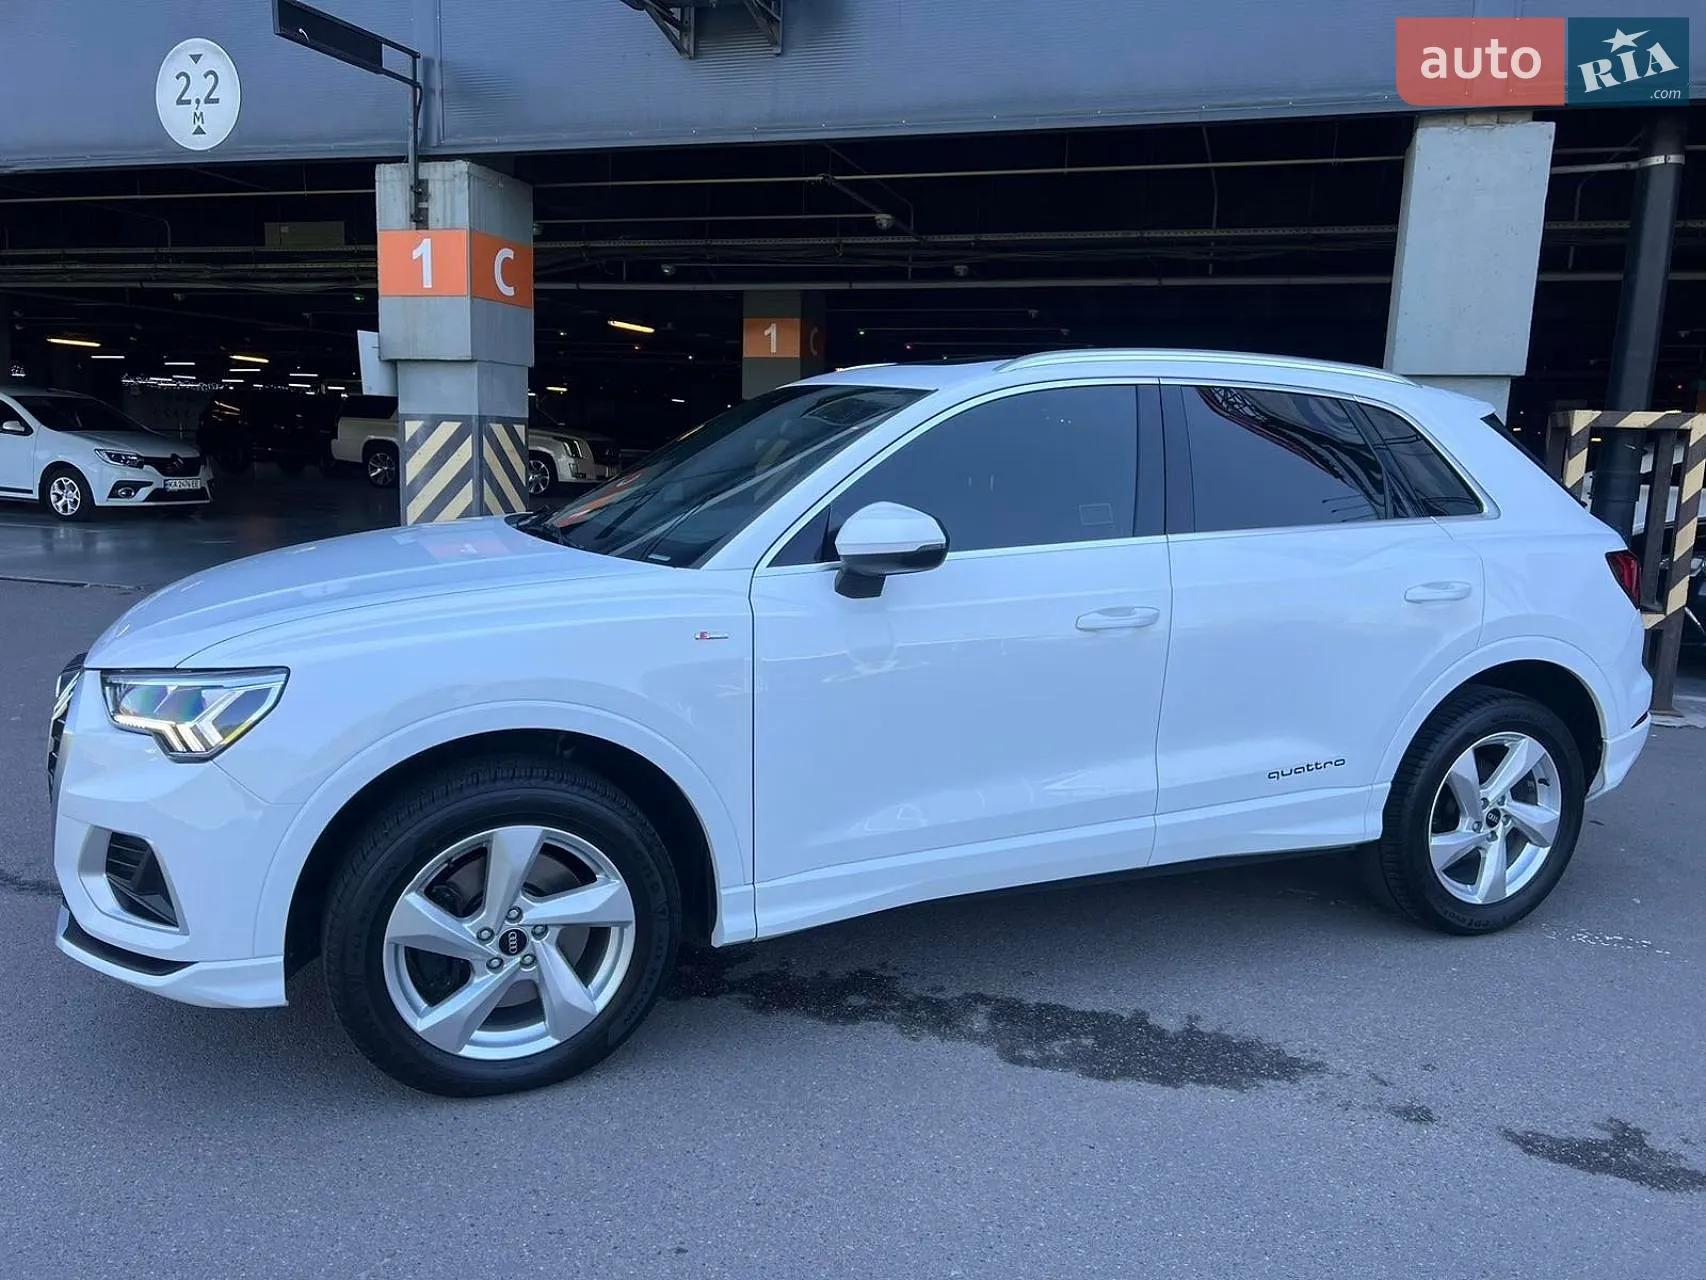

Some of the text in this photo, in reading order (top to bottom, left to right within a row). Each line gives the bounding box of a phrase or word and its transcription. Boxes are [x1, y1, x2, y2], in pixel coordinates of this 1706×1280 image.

[175, 69, 220, 110] 2,2
[412, 238, 432, 288] 1
[494, 247, 515, 296] C
[764, 323, 776, 353] 1
[1267, 758, 1346, 780] quattro
